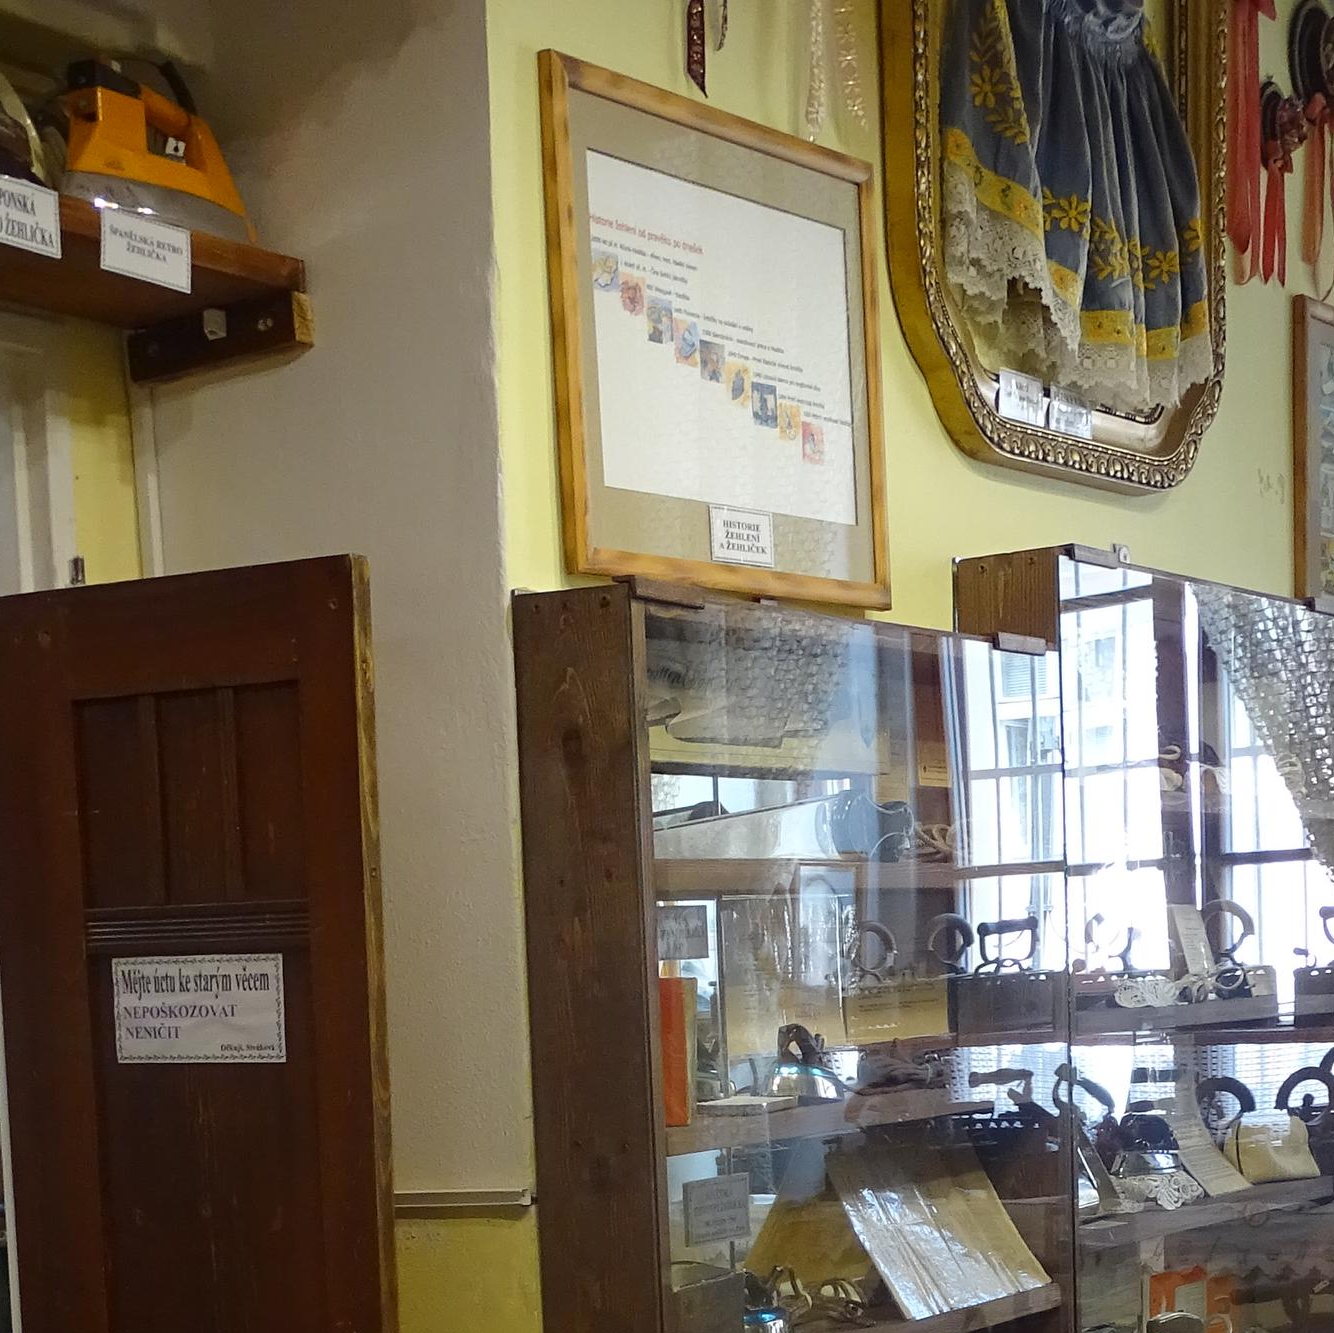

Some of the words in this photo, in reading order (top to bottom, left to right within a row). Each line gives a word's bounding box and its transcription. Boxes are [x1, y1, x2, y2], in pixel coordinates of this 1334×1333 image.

[5, 212, 54, 248] ŽEHLIČKA
[723, 520, 761, 532] HISTORIE
[725, 529, 760, 543] ŽEHLENÍ
[726, 540, 767, 554] ŽEHLIČEK
[121, 969, 151, 1001] Mějte
[154, 967, 175, 993] úctu
[178, 967, 191, 993] ke
[194, 966, 232, 999] starým
[236, 968, 269, 992] věcem
[124, 1002, 237, 1019] NEPOŠKOZOVAT
[125, 1022, 181, 1040] NENIČIT
